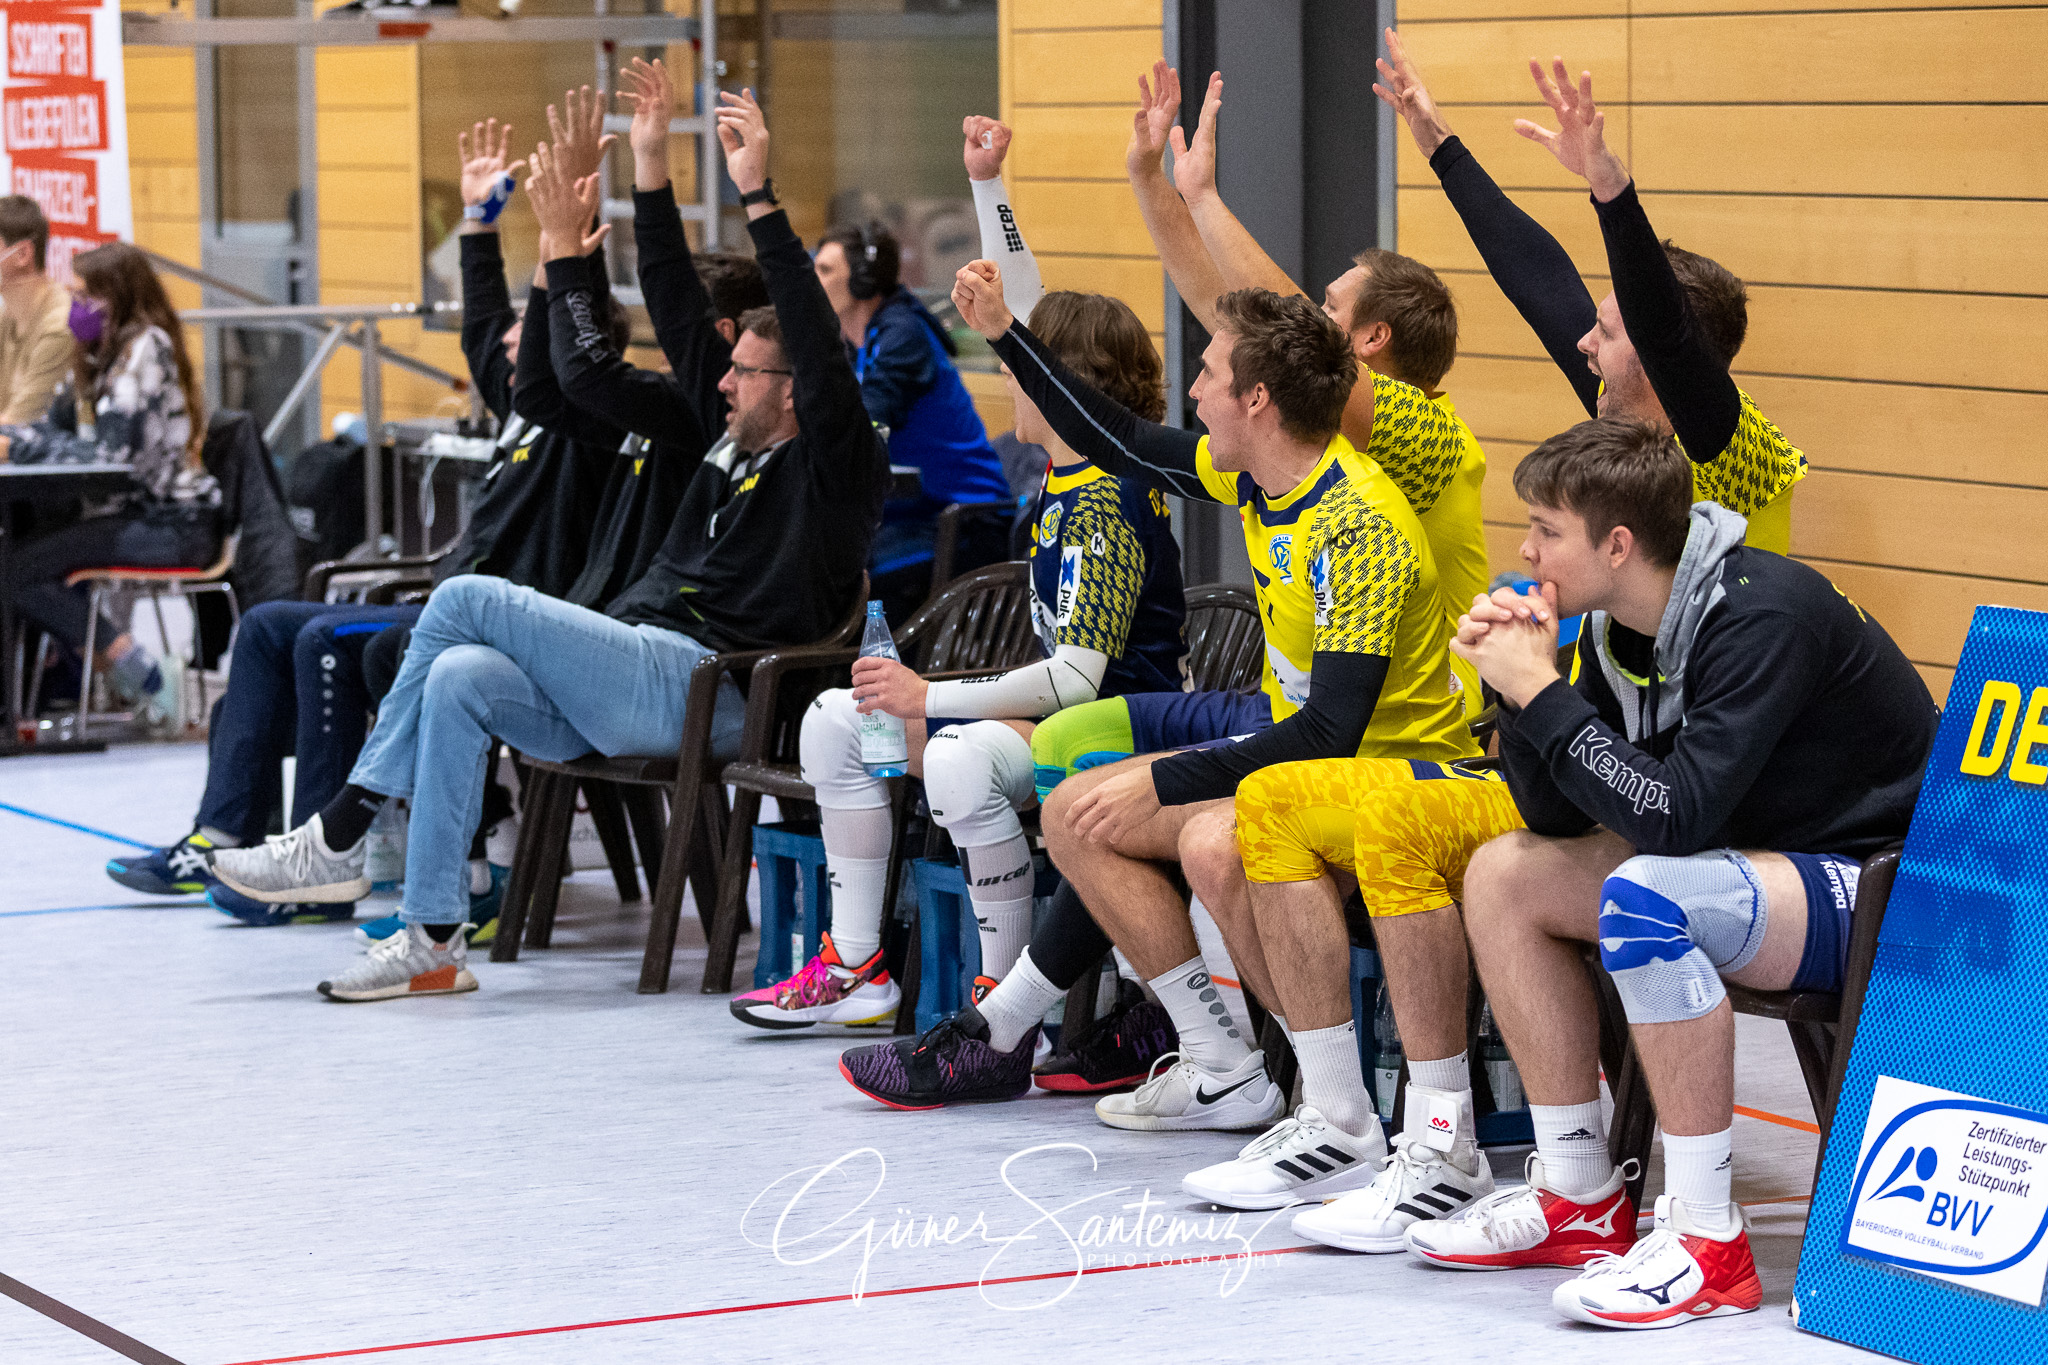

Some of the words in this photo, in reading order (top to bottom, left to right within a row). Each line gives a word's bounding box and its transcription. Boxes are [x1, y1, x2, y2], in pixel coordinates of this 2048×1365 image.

[997, 204, 1018, 232] cep
[1058, 588, 1072, 619] puls
[1820, 860, 1847, 909] Kempa
[1967, 1121, 2047, 1154] Zertifizierter
[1963, 1142, 2032, 1175] Leistungs-
[1958, 1165, 2030, 1198] Stützpunkt
[1926, 1191, 1994, 1237] BVV
[1855, 1218, 1903, 1238] BAYERISCHER
[1904, 1231, 1984, 1260] VOLLEYBALL-VERBAND
